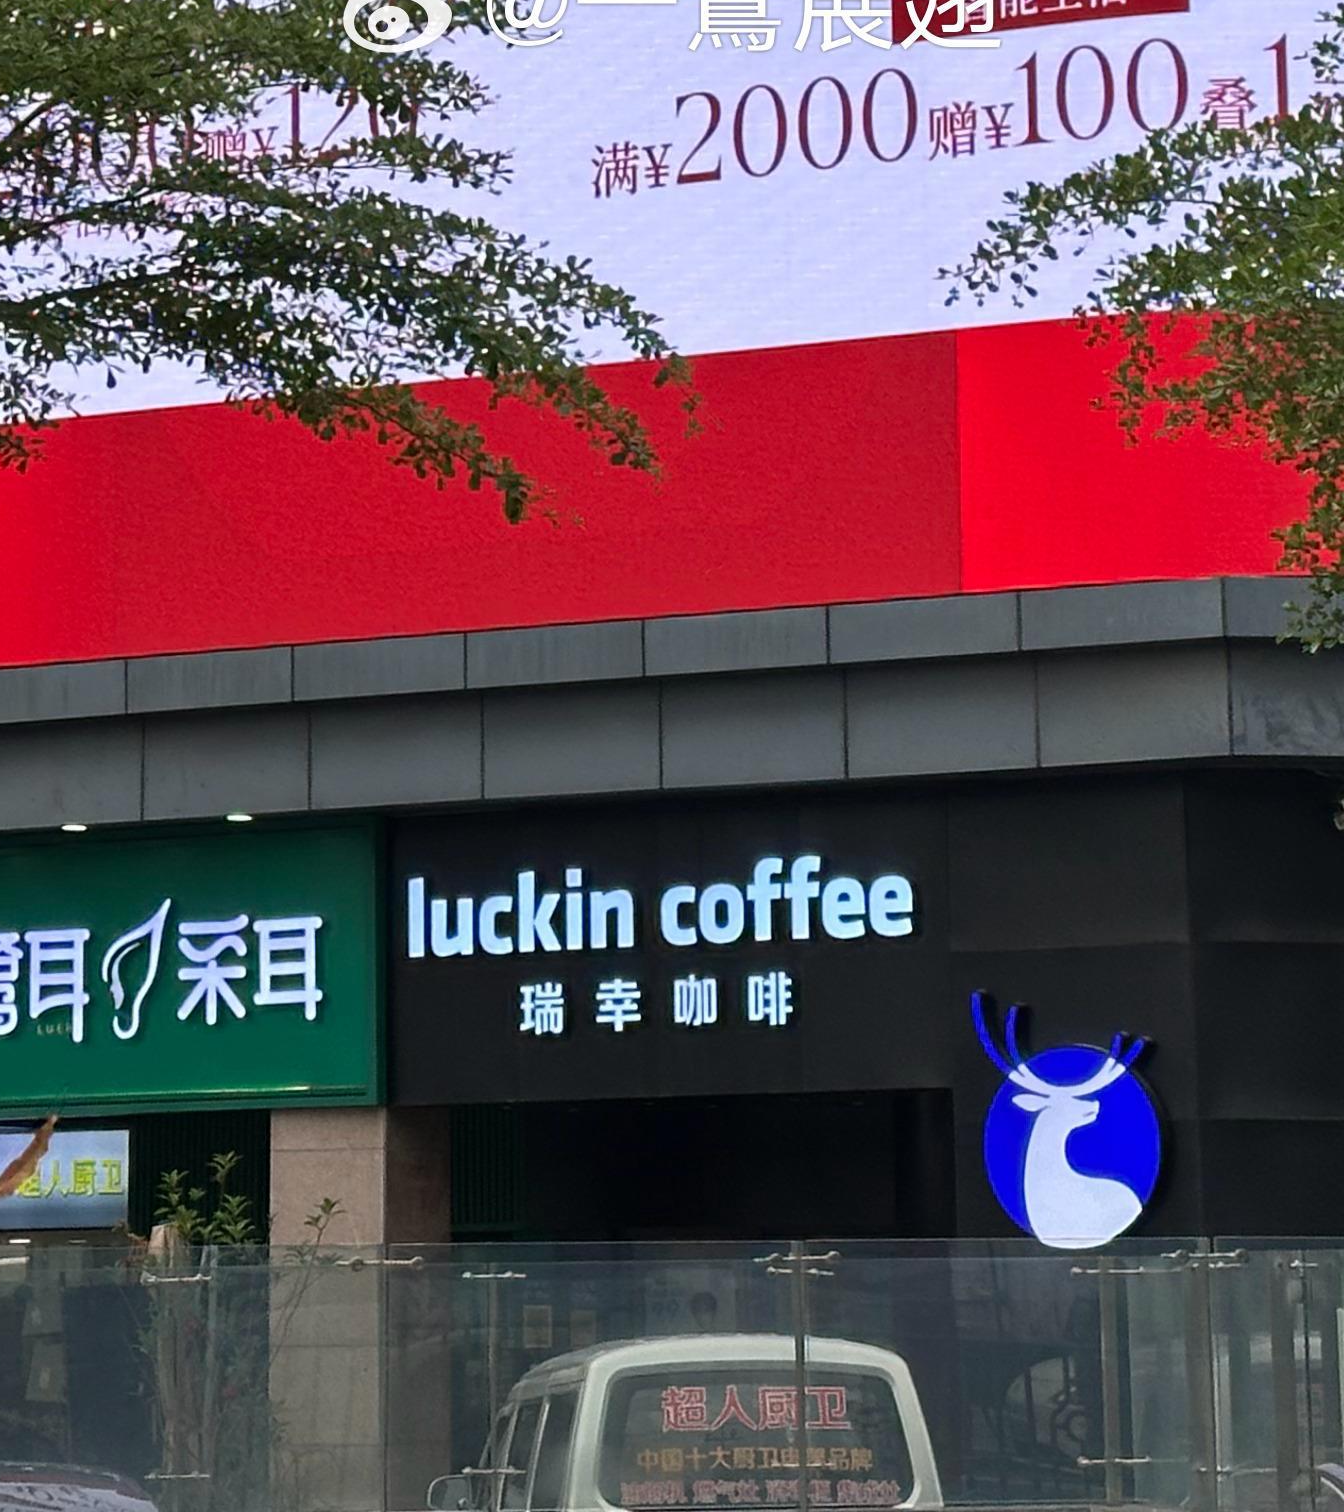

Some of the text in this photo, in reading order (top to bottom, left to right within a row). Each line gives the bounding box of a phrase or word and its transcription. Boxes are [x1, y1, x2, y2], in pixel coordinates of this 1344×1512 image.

[407, 855, 914, 958] luckin coffee
[519, 970, 793, 1036] 瑞幸咖啡
[662, 1385, 853, 1432] 超人厨卫
